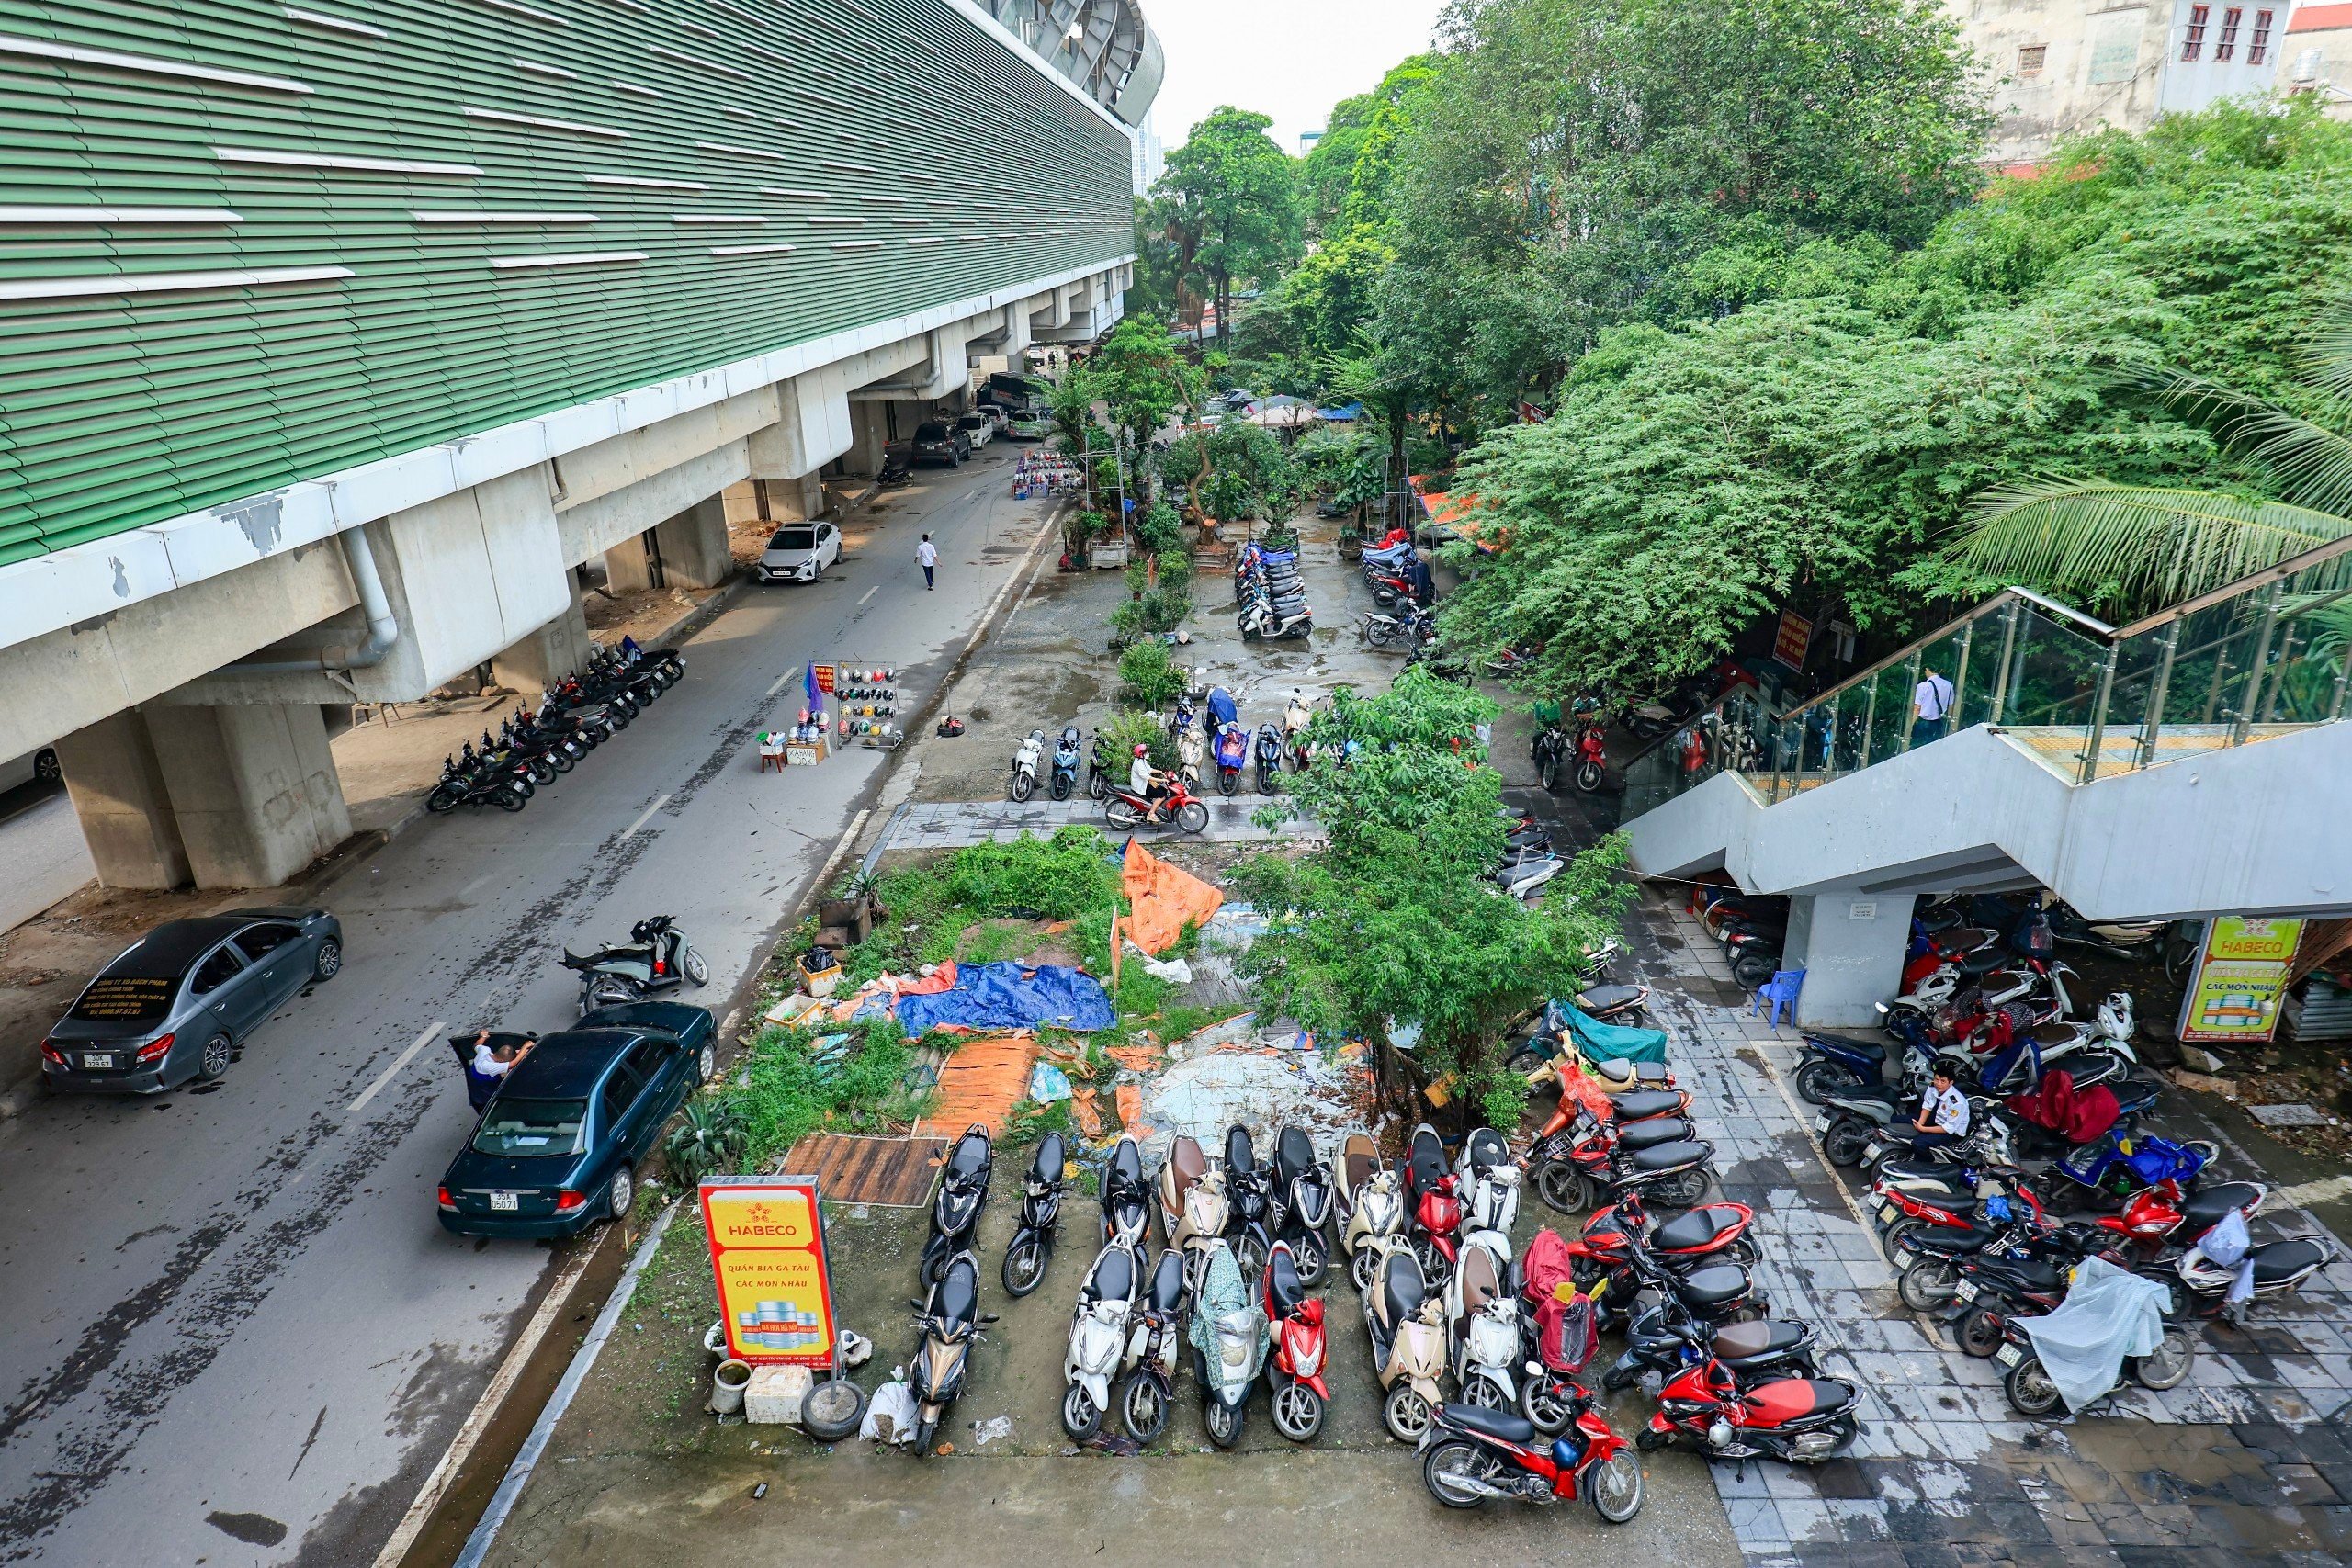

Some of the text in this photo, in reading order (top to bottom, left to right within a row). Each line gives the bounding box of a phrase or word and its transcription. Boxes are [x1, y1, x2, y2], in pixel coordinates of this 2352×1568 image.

[2220, 940, 2283, 953] HABECO
[729, 1225, 797, 1236] HABECO
[728, 1264, 754, 1273] QUÁN
[792, 1264, 810, 1272] TÀU
[735, 1280, 753, 1288] CÁC
[781, 1279, 808, 1289] NHẬU
